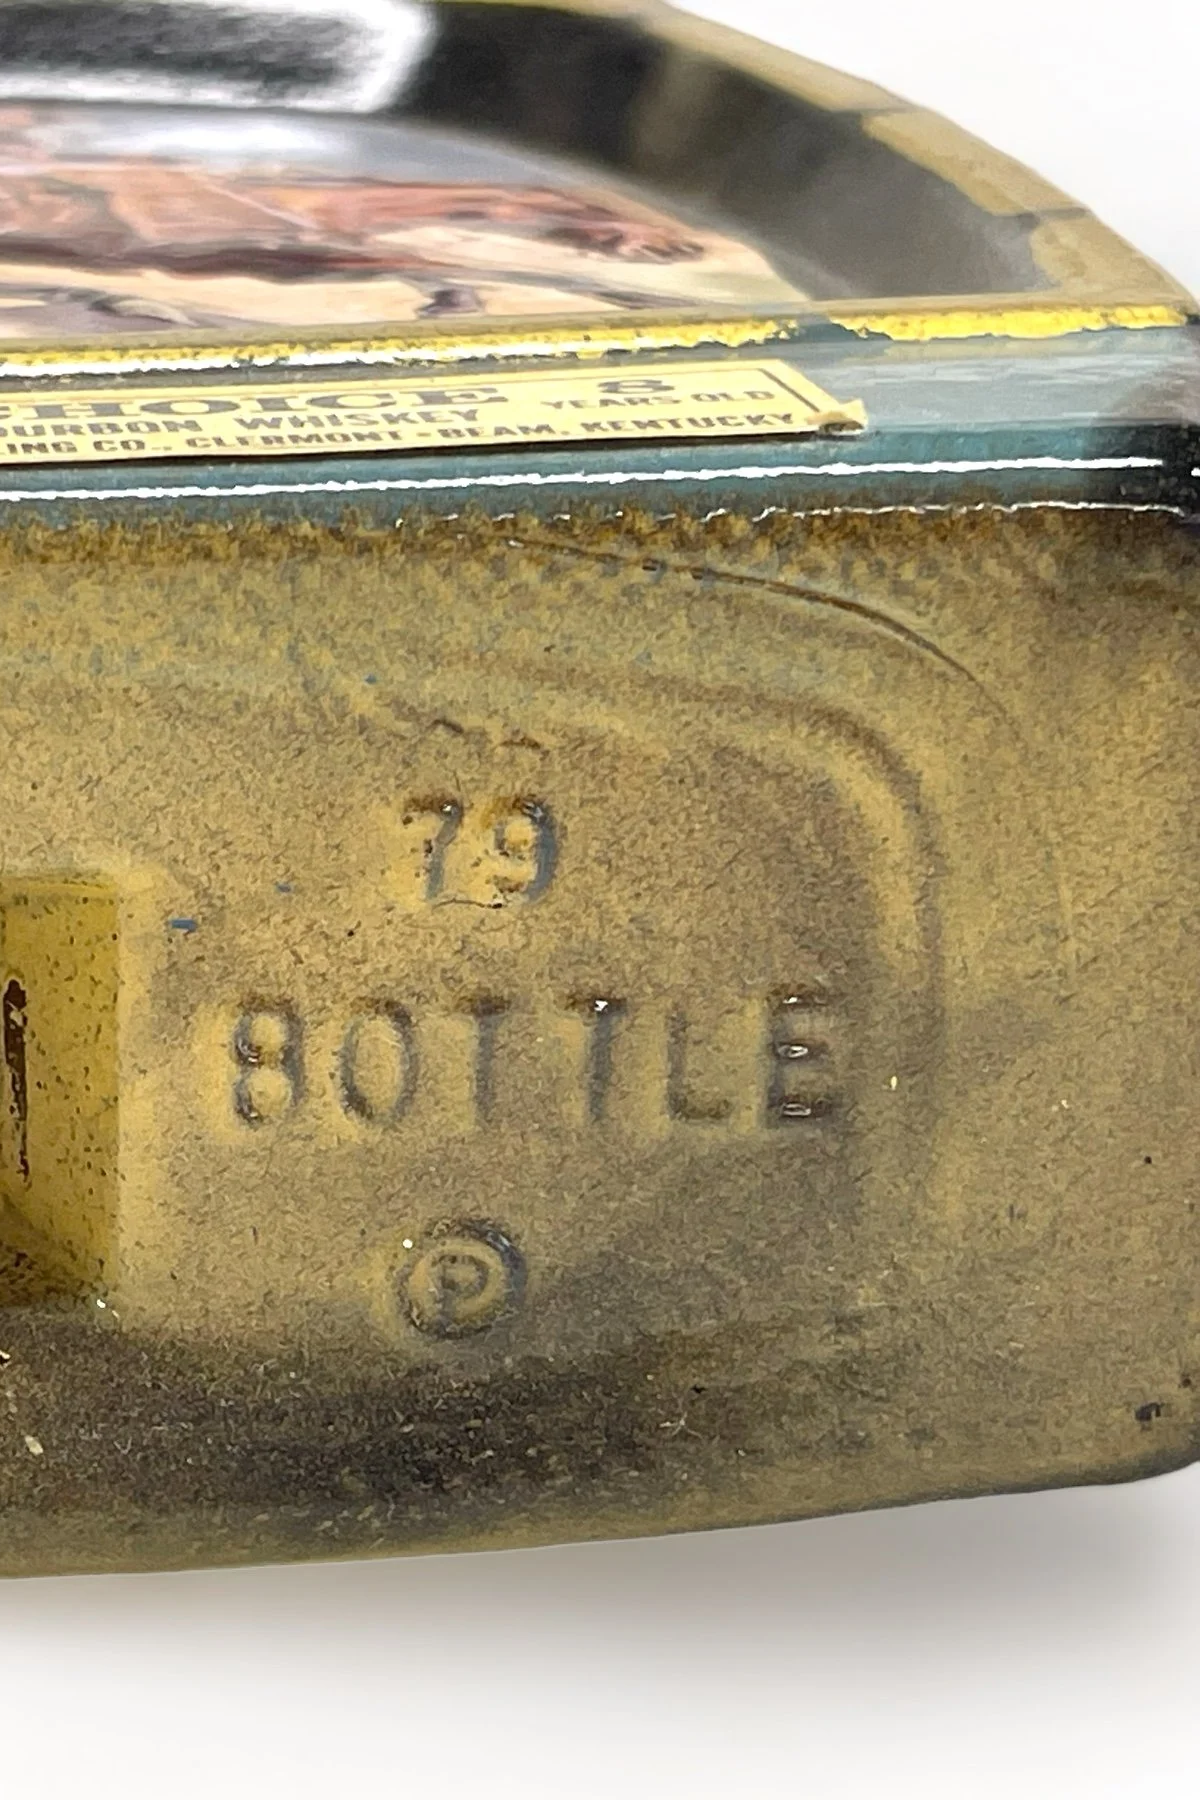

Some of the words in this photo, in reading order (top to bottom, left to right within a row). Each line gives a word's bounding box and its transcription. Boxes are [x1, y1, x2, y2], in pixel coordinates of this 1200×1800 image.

[596, 379, 677, 394] 8
[540, 396, 682, 410] YEARS
[689, 390, 776, 403] OLD
[233, 408, 480, 430] WHISKEY
[580, 412, 795, 432] KENTUCKY
[402, 795, 560, 905] 79
[232, 988, 842, 1128] BOTTLE
